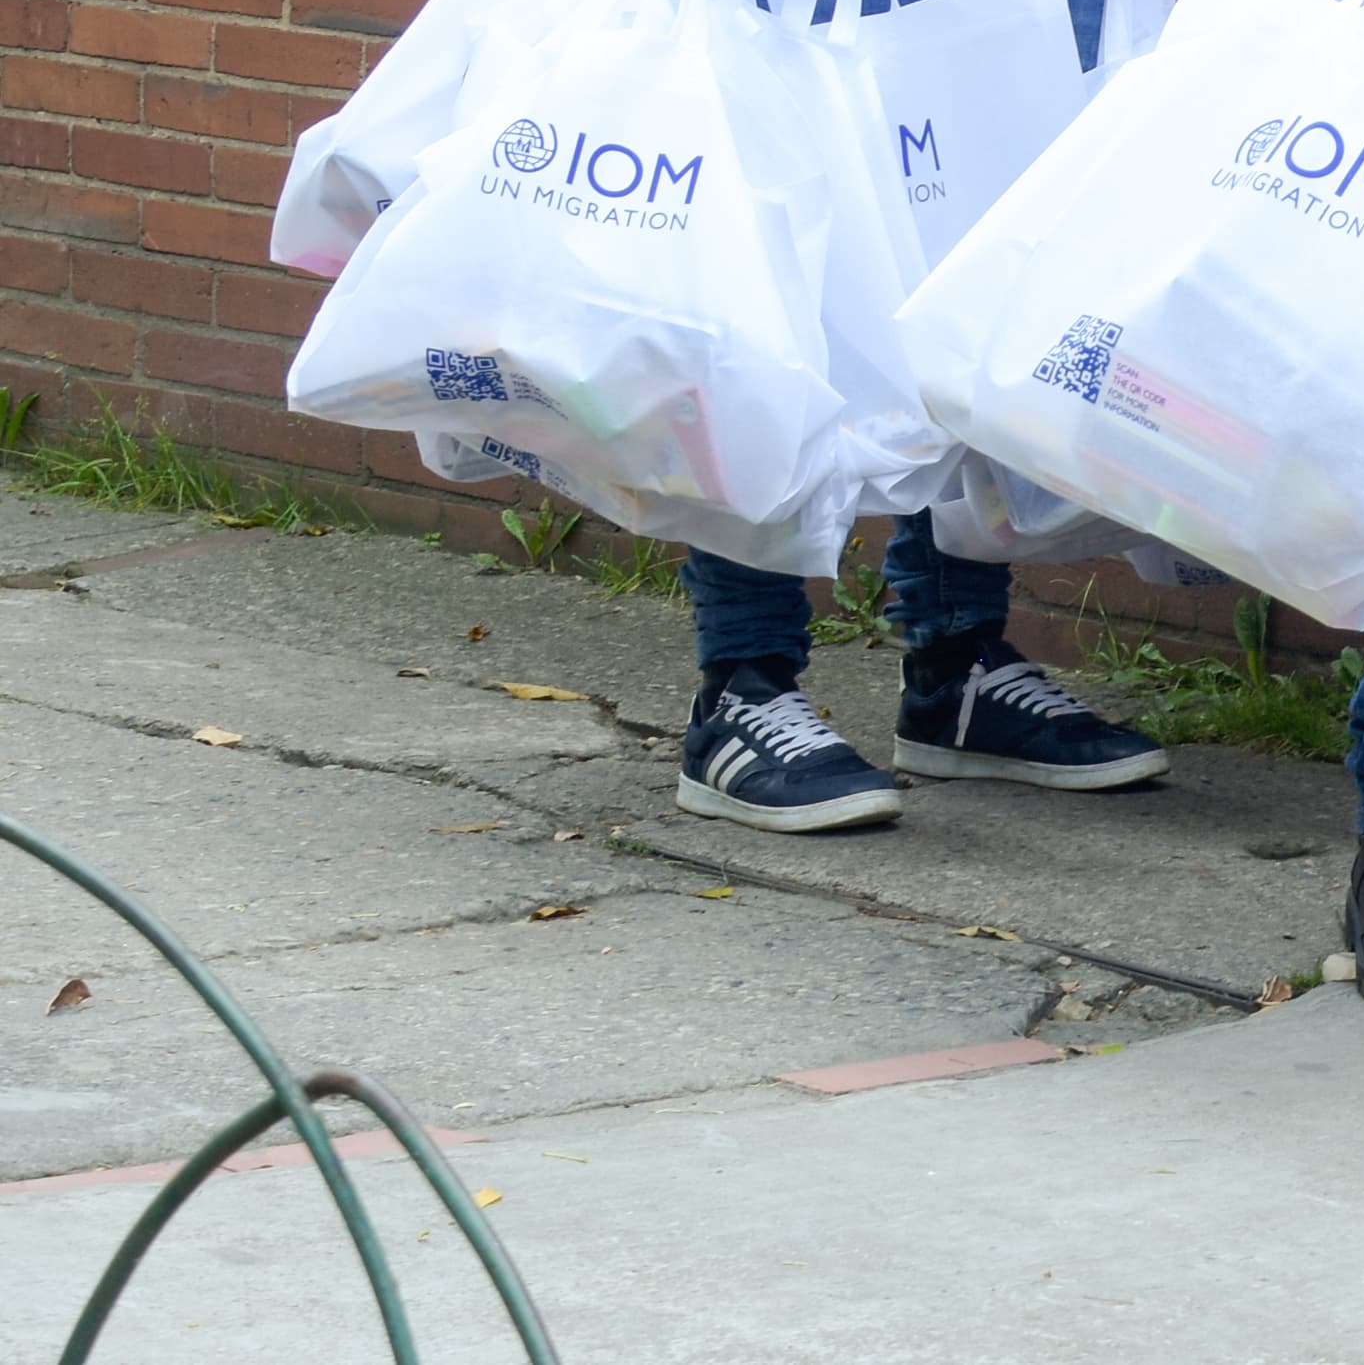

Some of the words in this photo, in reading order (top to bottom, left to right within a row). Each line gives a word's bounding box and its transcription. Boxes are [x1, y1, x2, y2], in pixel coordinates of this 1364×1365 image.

[565, 132, 703, 205] IOM
[480, 175, 521, 200] UN
[533, 186, 689, 232] MIGRATION
[1113, 375, 1128, 388] THE
[1143, 389, 1166, 407] CODE
[1103, 400, 1161, 432] INFORMATION
